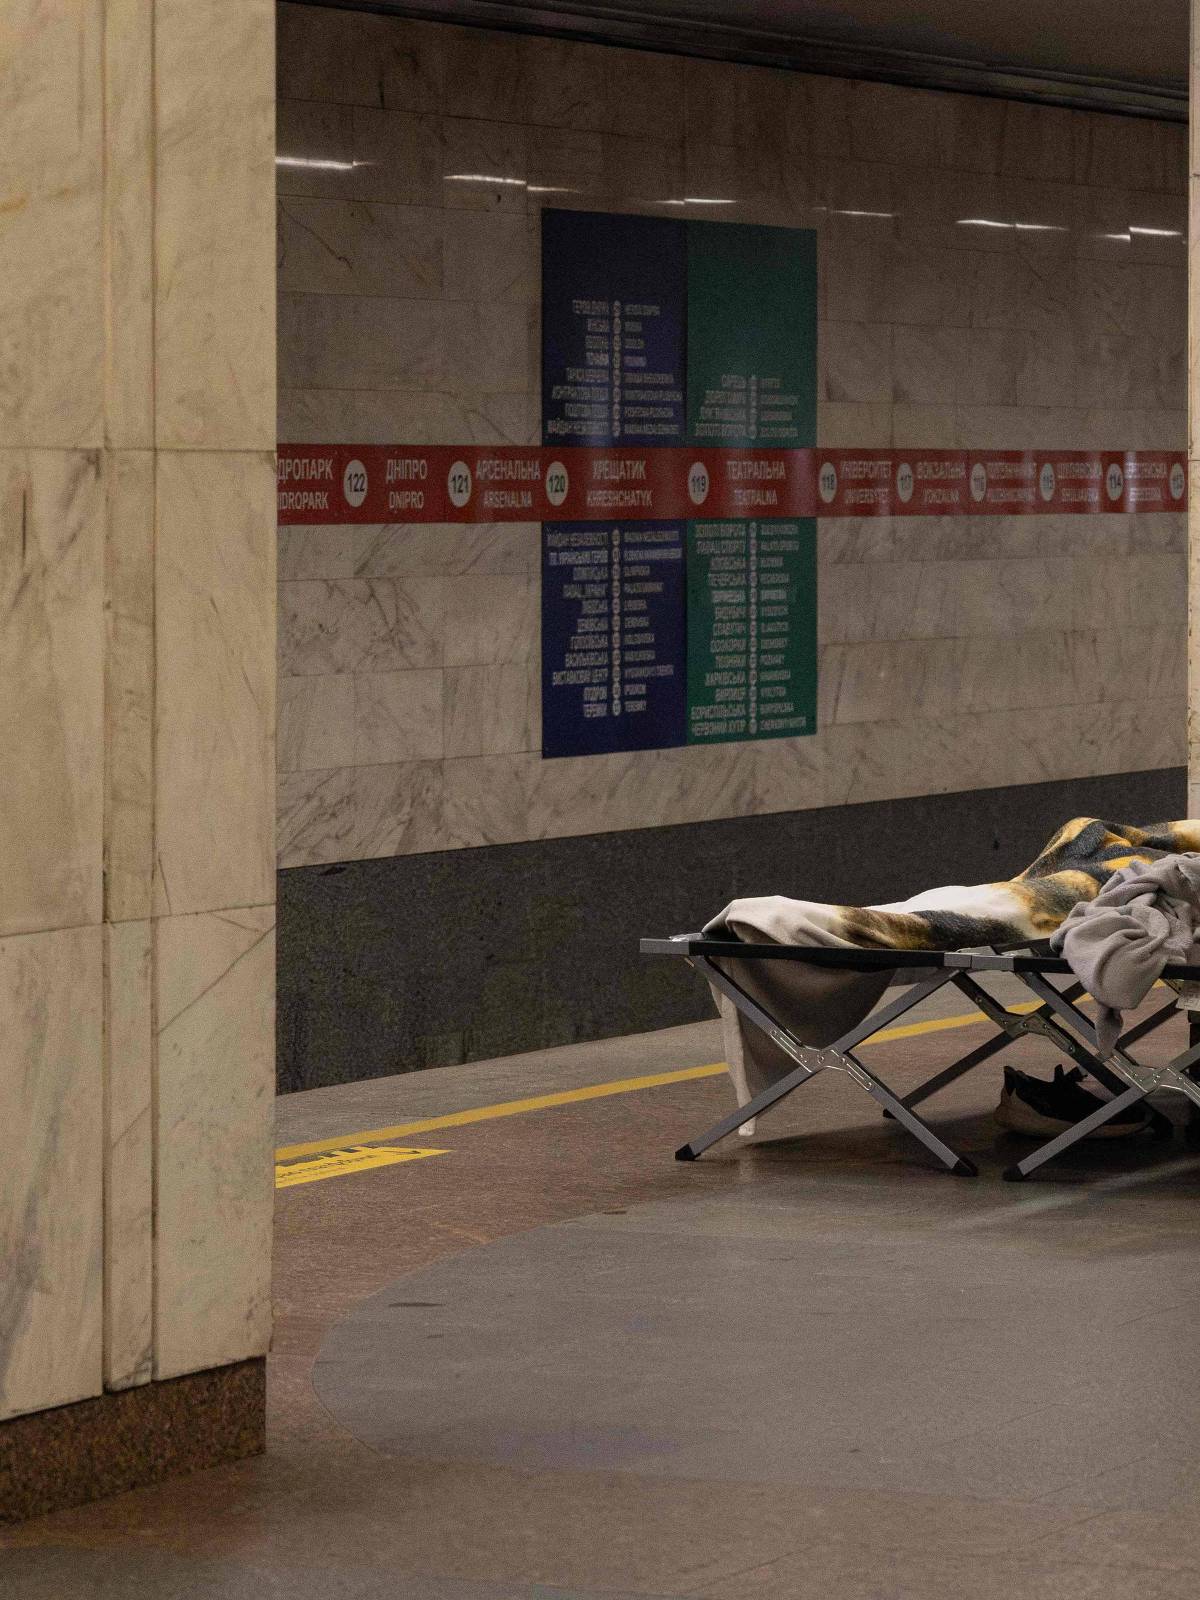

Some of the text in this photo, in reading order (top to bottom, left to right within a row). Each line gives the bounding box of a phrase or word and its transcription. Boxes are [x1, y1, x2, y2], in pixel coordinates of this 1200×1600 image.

[385, 458, 428, 483] ДНІПРО
[347, 474, 365, 492] 122
[451, 474, 469, 492] 121
[388, 490, 424, 510] DNIPRO
